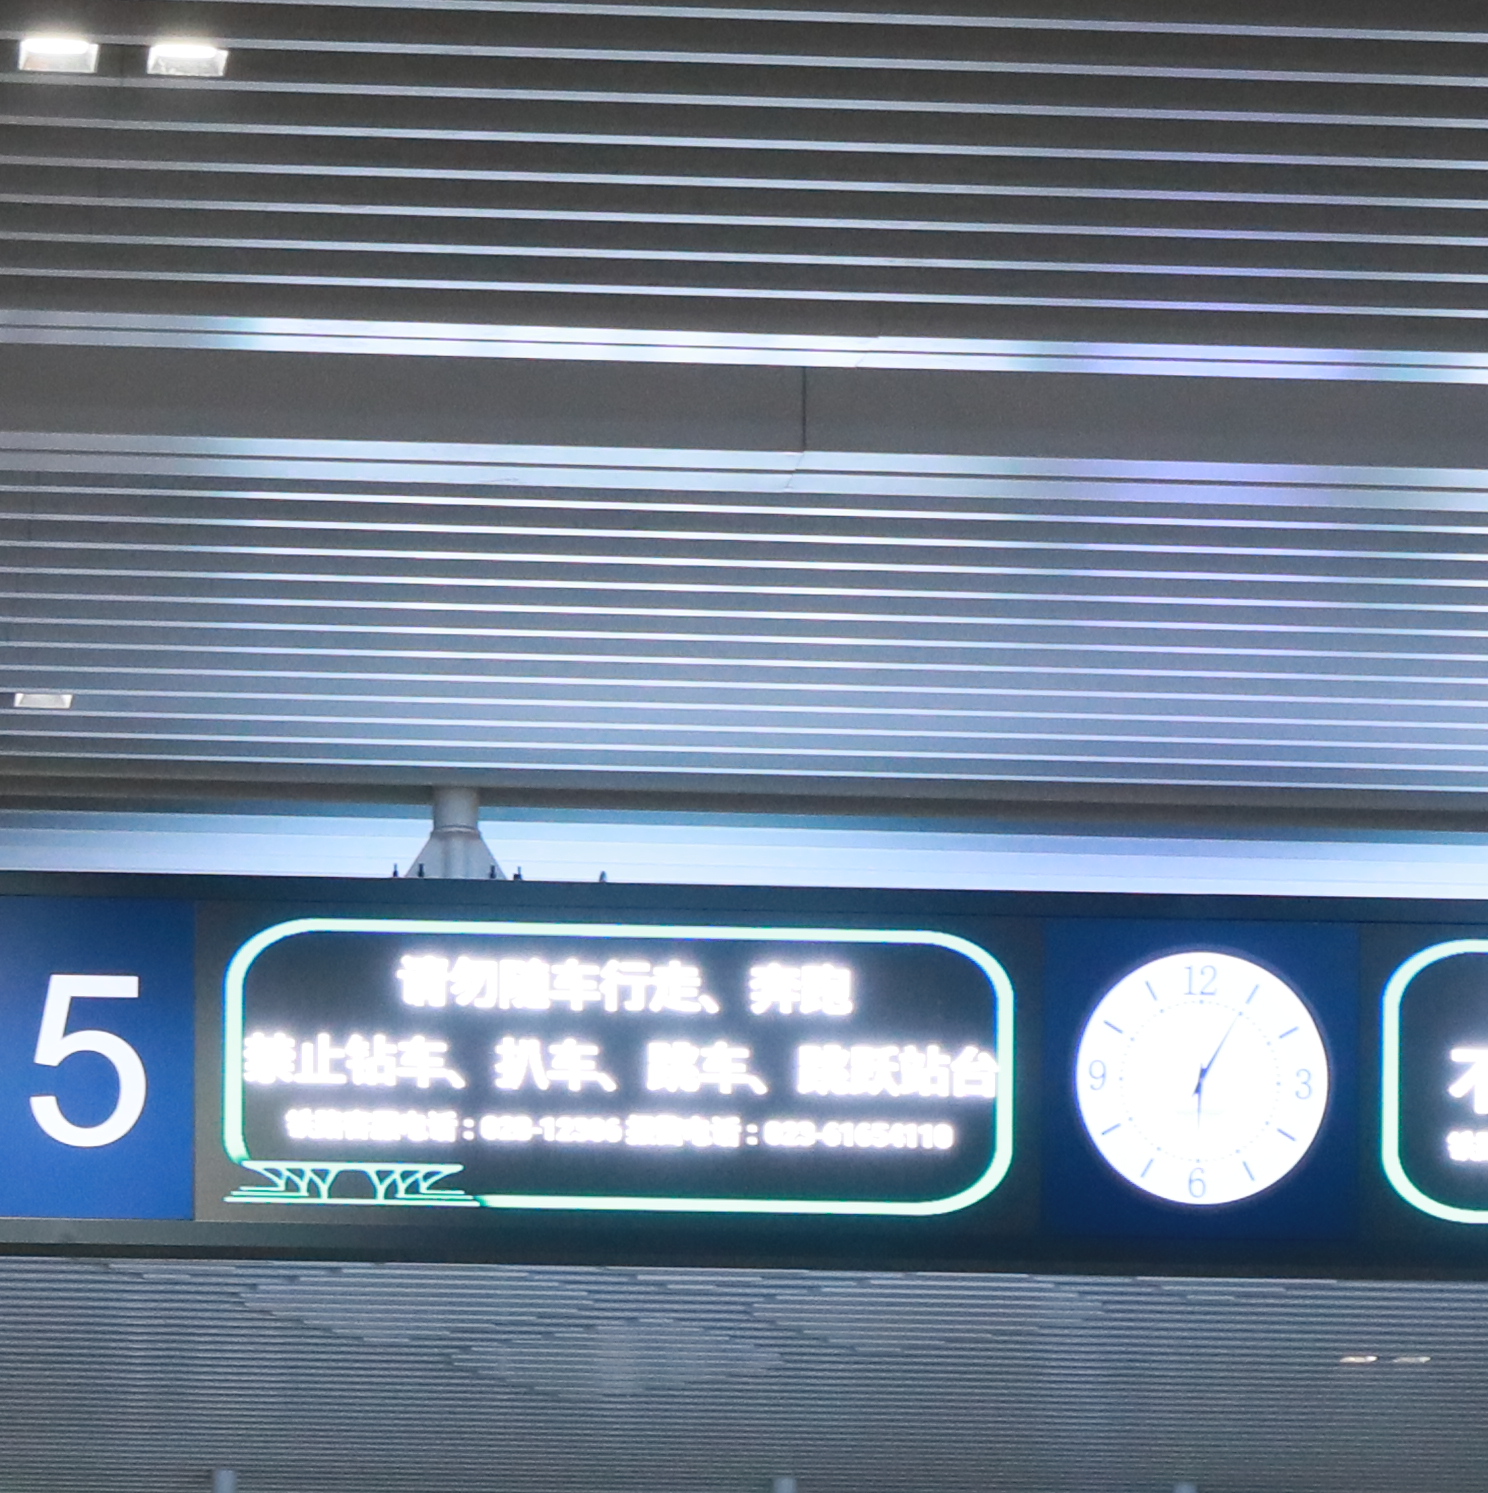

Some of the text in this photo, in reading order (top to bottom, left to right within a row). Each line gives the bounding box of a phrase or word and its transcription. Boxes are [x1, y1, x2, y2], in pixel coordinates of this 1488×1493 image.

[1184, 965, 1217, 996] 12
[1089, 1060, 1106, 1090] 9
[1295, 1069, 1312, 1099] 3
[1188, 1168, 1206, 1197] 6
